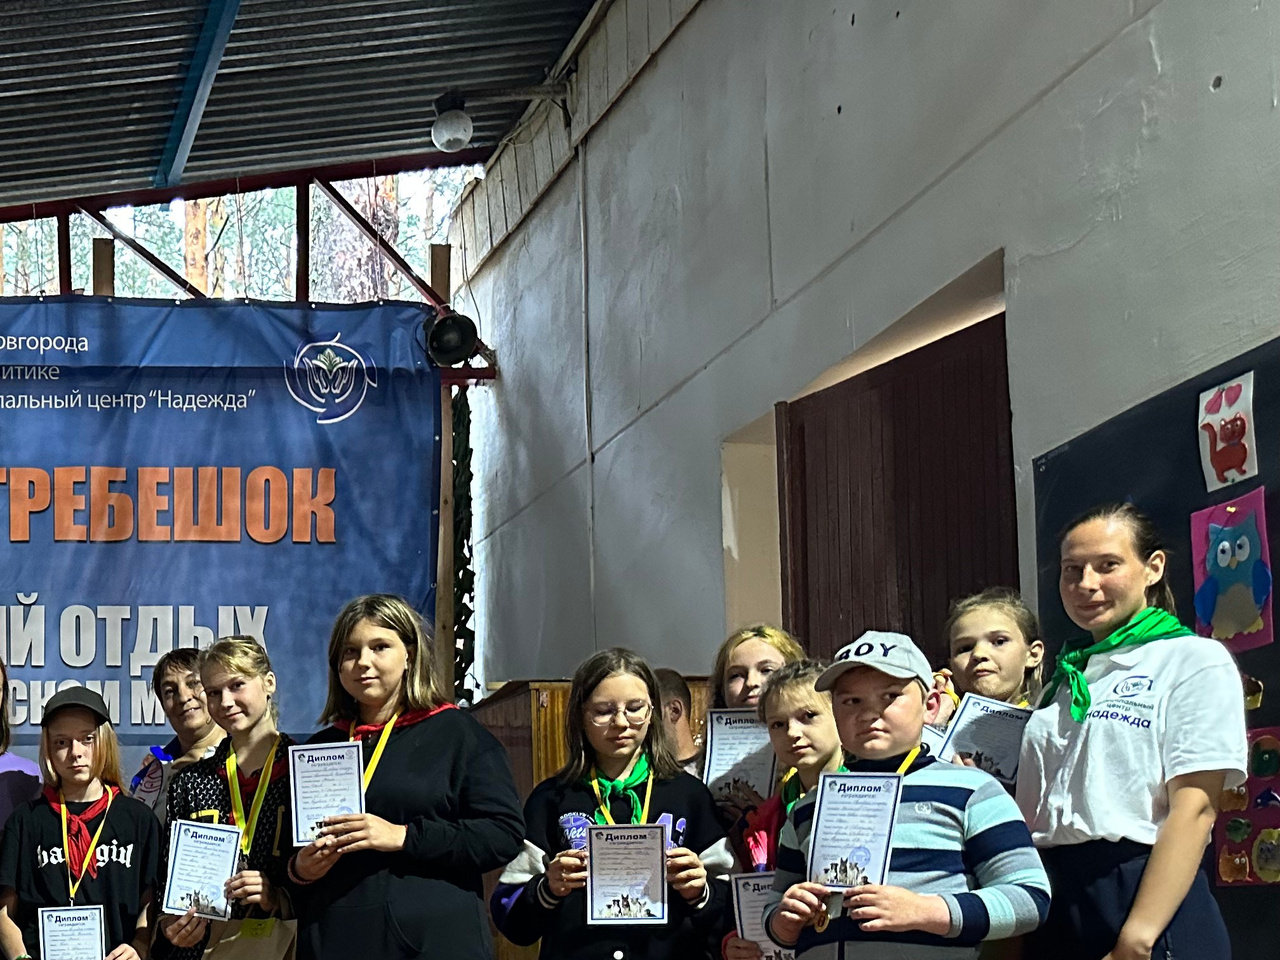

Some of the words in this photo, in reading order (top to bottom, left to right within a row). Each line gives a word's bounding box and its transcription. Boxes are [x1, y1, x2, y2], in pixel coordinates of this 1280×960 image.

[88, 393, 146, 413] центр
[980, 705, 1024, 720] Диплом
[724, 717, 756, 726] Дипло
[306, 754, 345, 763] Диплом
[837, 783, 882, 793] Диплом
[190, 831, 225, 843] Диплом
[605, 833, 647, 842] Диплом
[54, 915, 89, 924] Диплом
